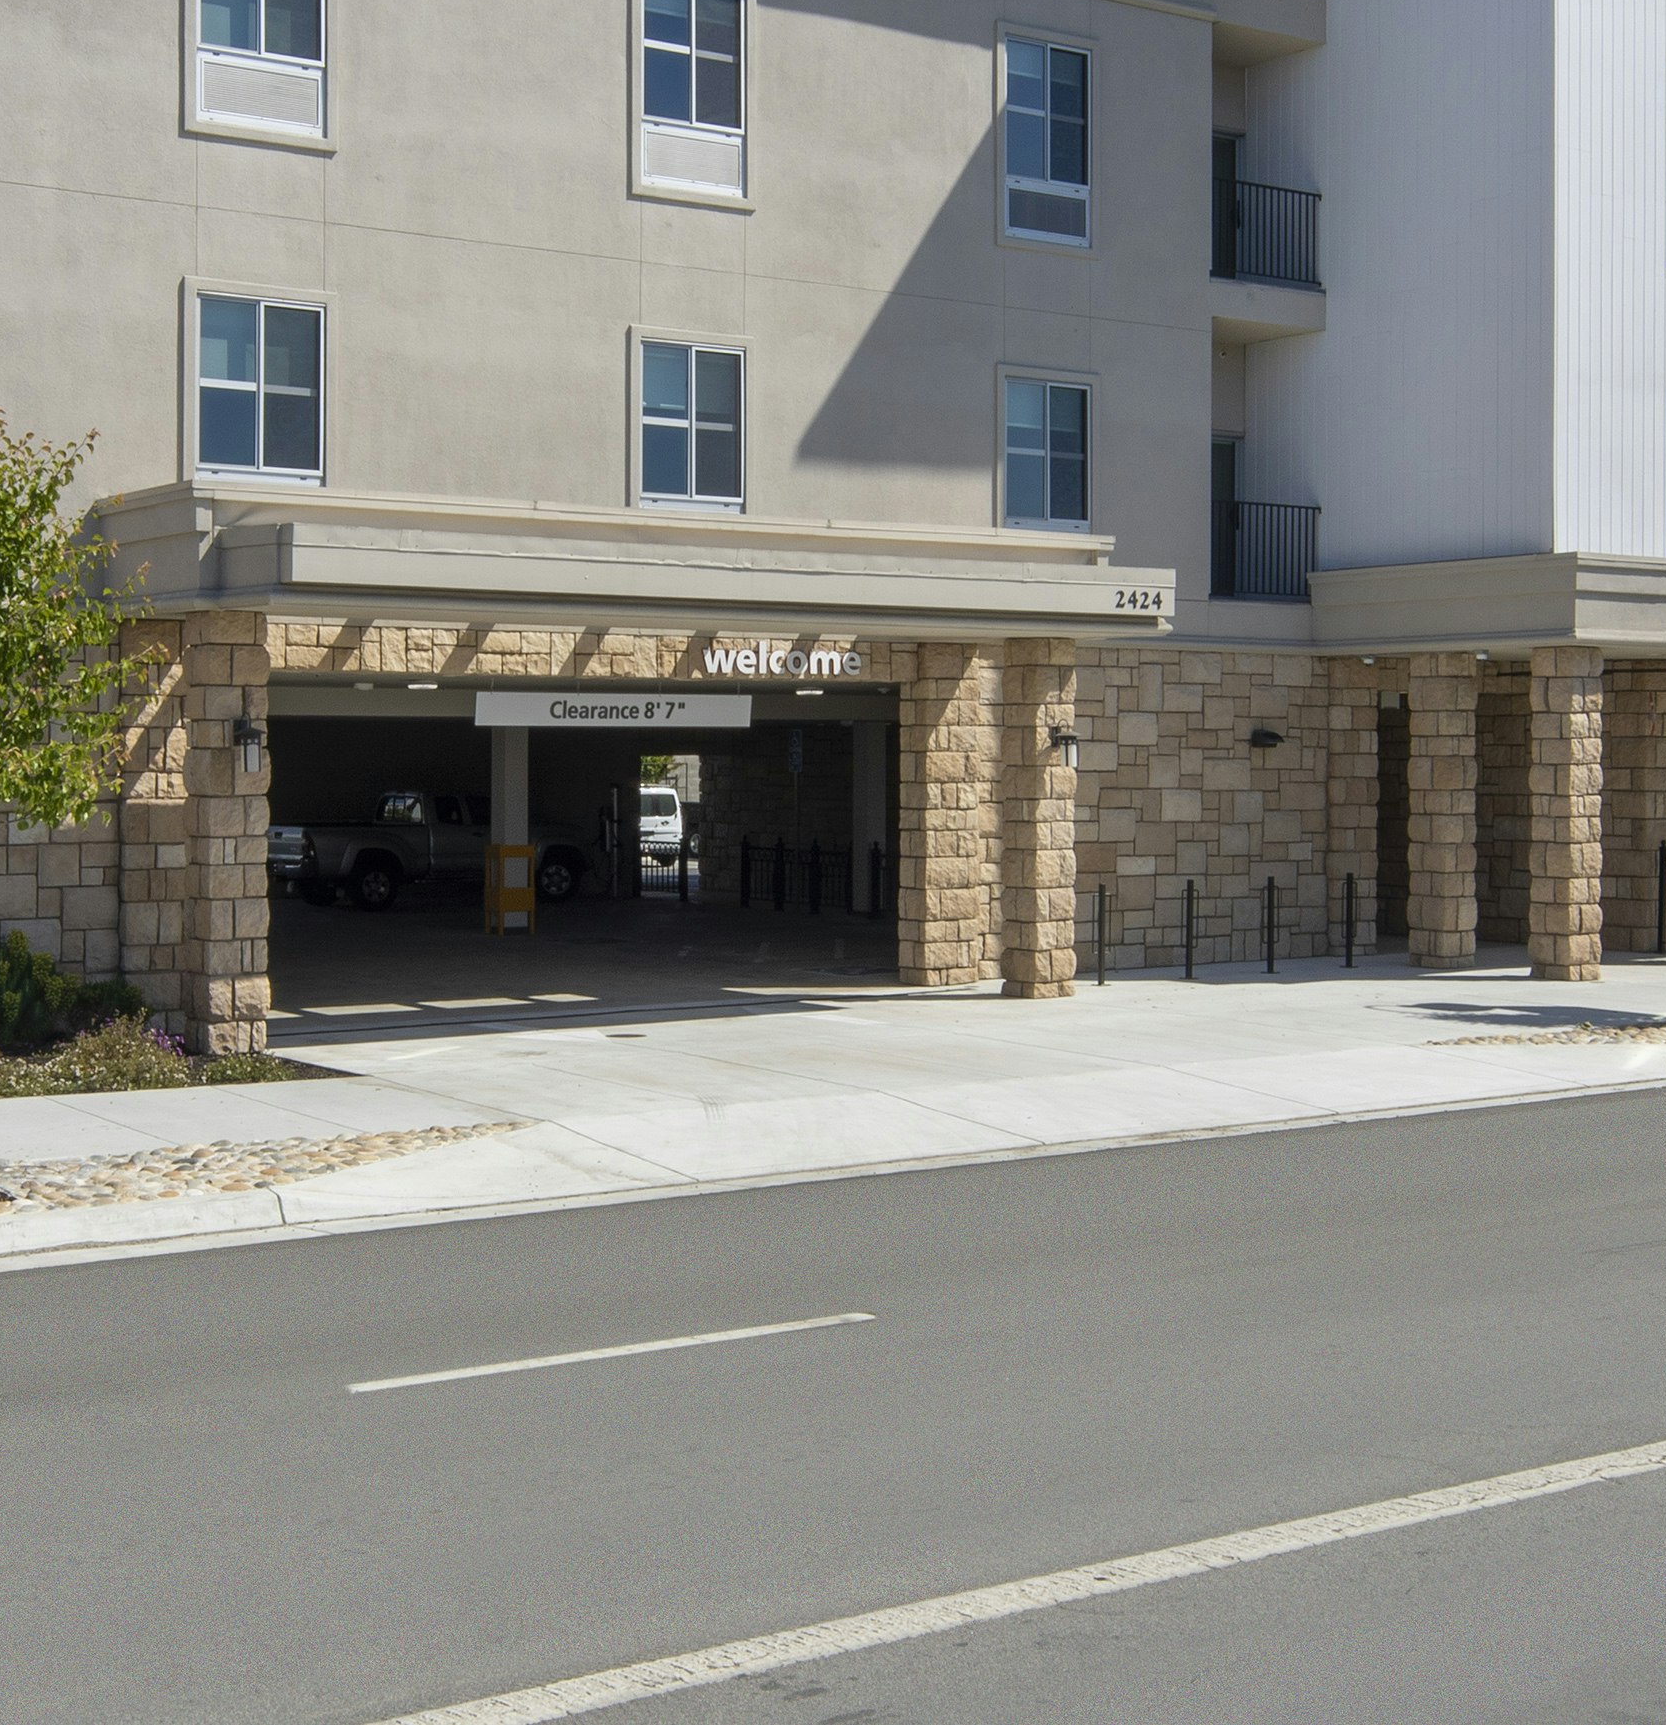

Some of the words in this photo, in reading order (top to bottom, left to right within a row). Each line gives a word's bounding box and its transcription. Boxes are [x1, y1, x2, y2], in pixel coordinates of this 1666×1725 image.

[1115, 590, 1163, 610] 2424
[703, 639, 862, 675] welcome
[549, 700, 640, 719] Clearance
[644, 701, 660, 719] 8'
[665, 702, 686, 719] 7"
